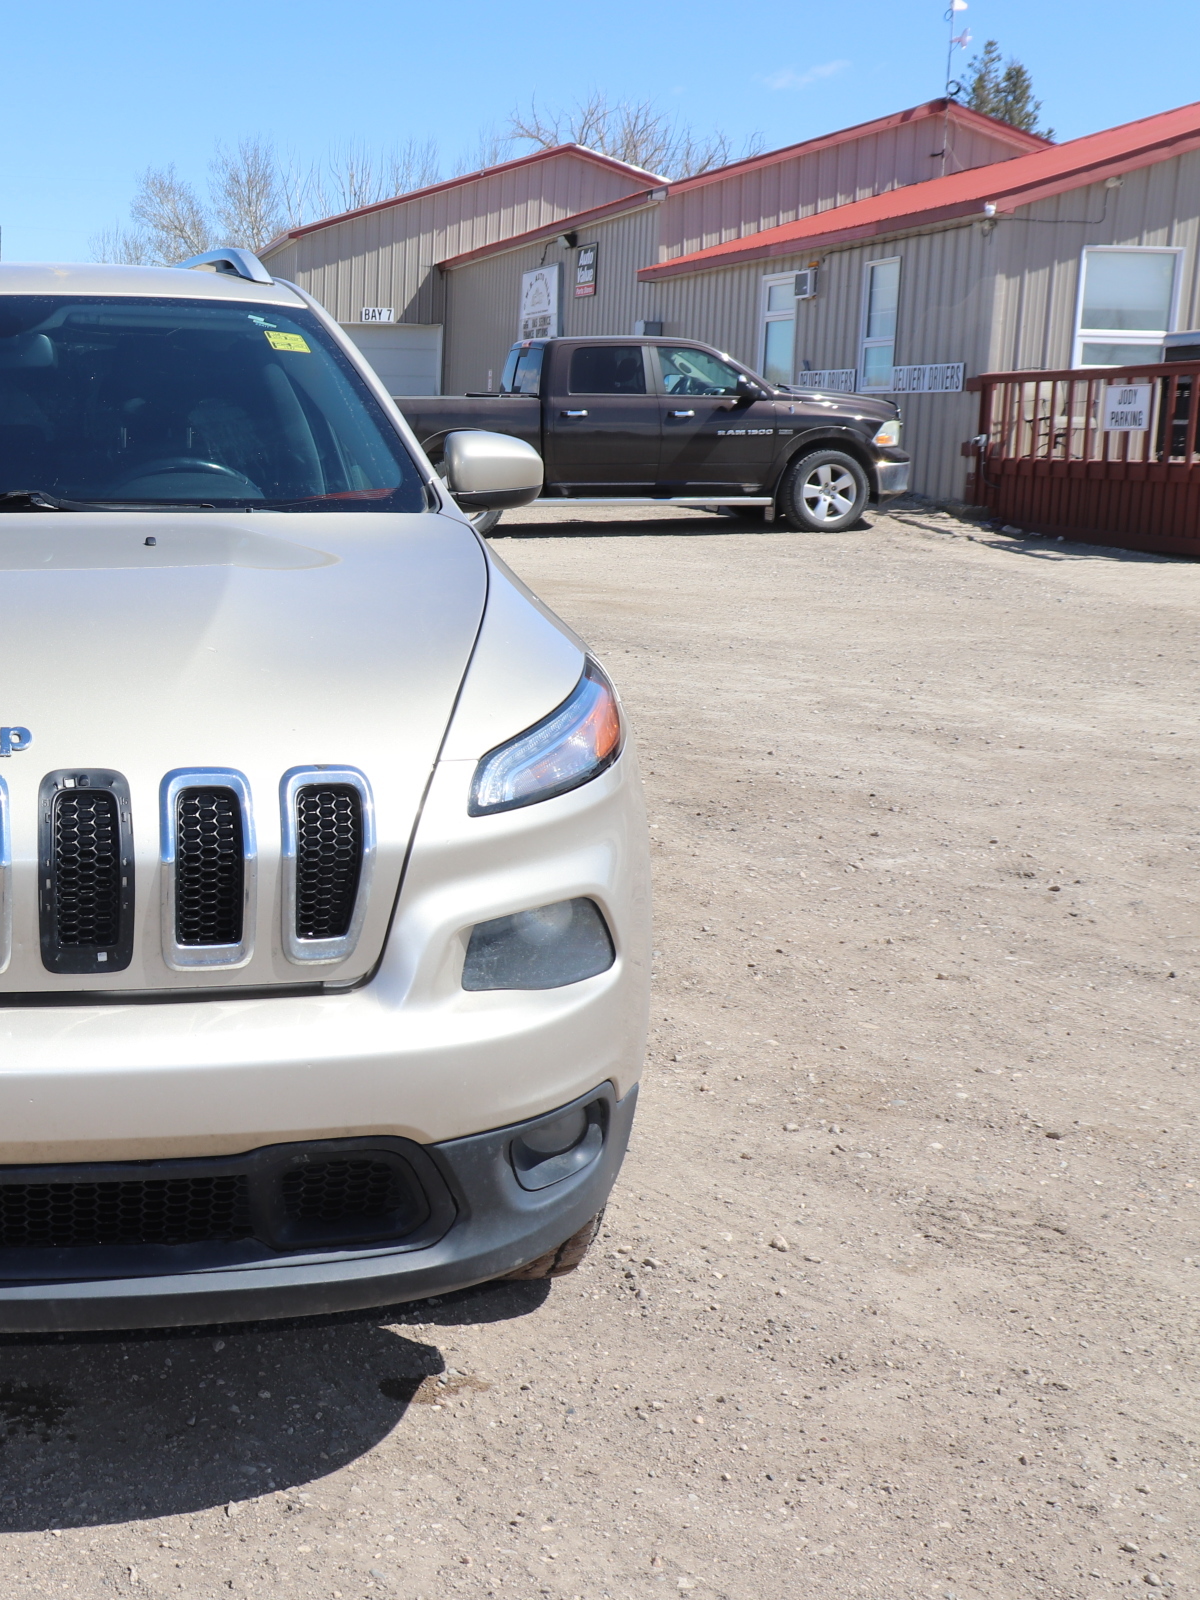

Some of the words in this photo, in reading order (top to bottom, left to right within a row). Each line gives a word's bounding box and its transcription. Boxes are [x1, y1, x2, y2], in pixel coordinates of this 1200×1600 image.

[578, 249, 594, 266] Auto
[577, 266, 594, 283] Value
[364, 308, 383, 321] BAY
[386, 308, 392, 321] 7
[893, 366, 927, 392] DELIVERY
[928, 364, 961, 391] DRIVERS
[1118, 388, 1139, 405] JODY
[1110, 410, 1144, 427] PARKING
[717, 428, 746, 436] RAM
